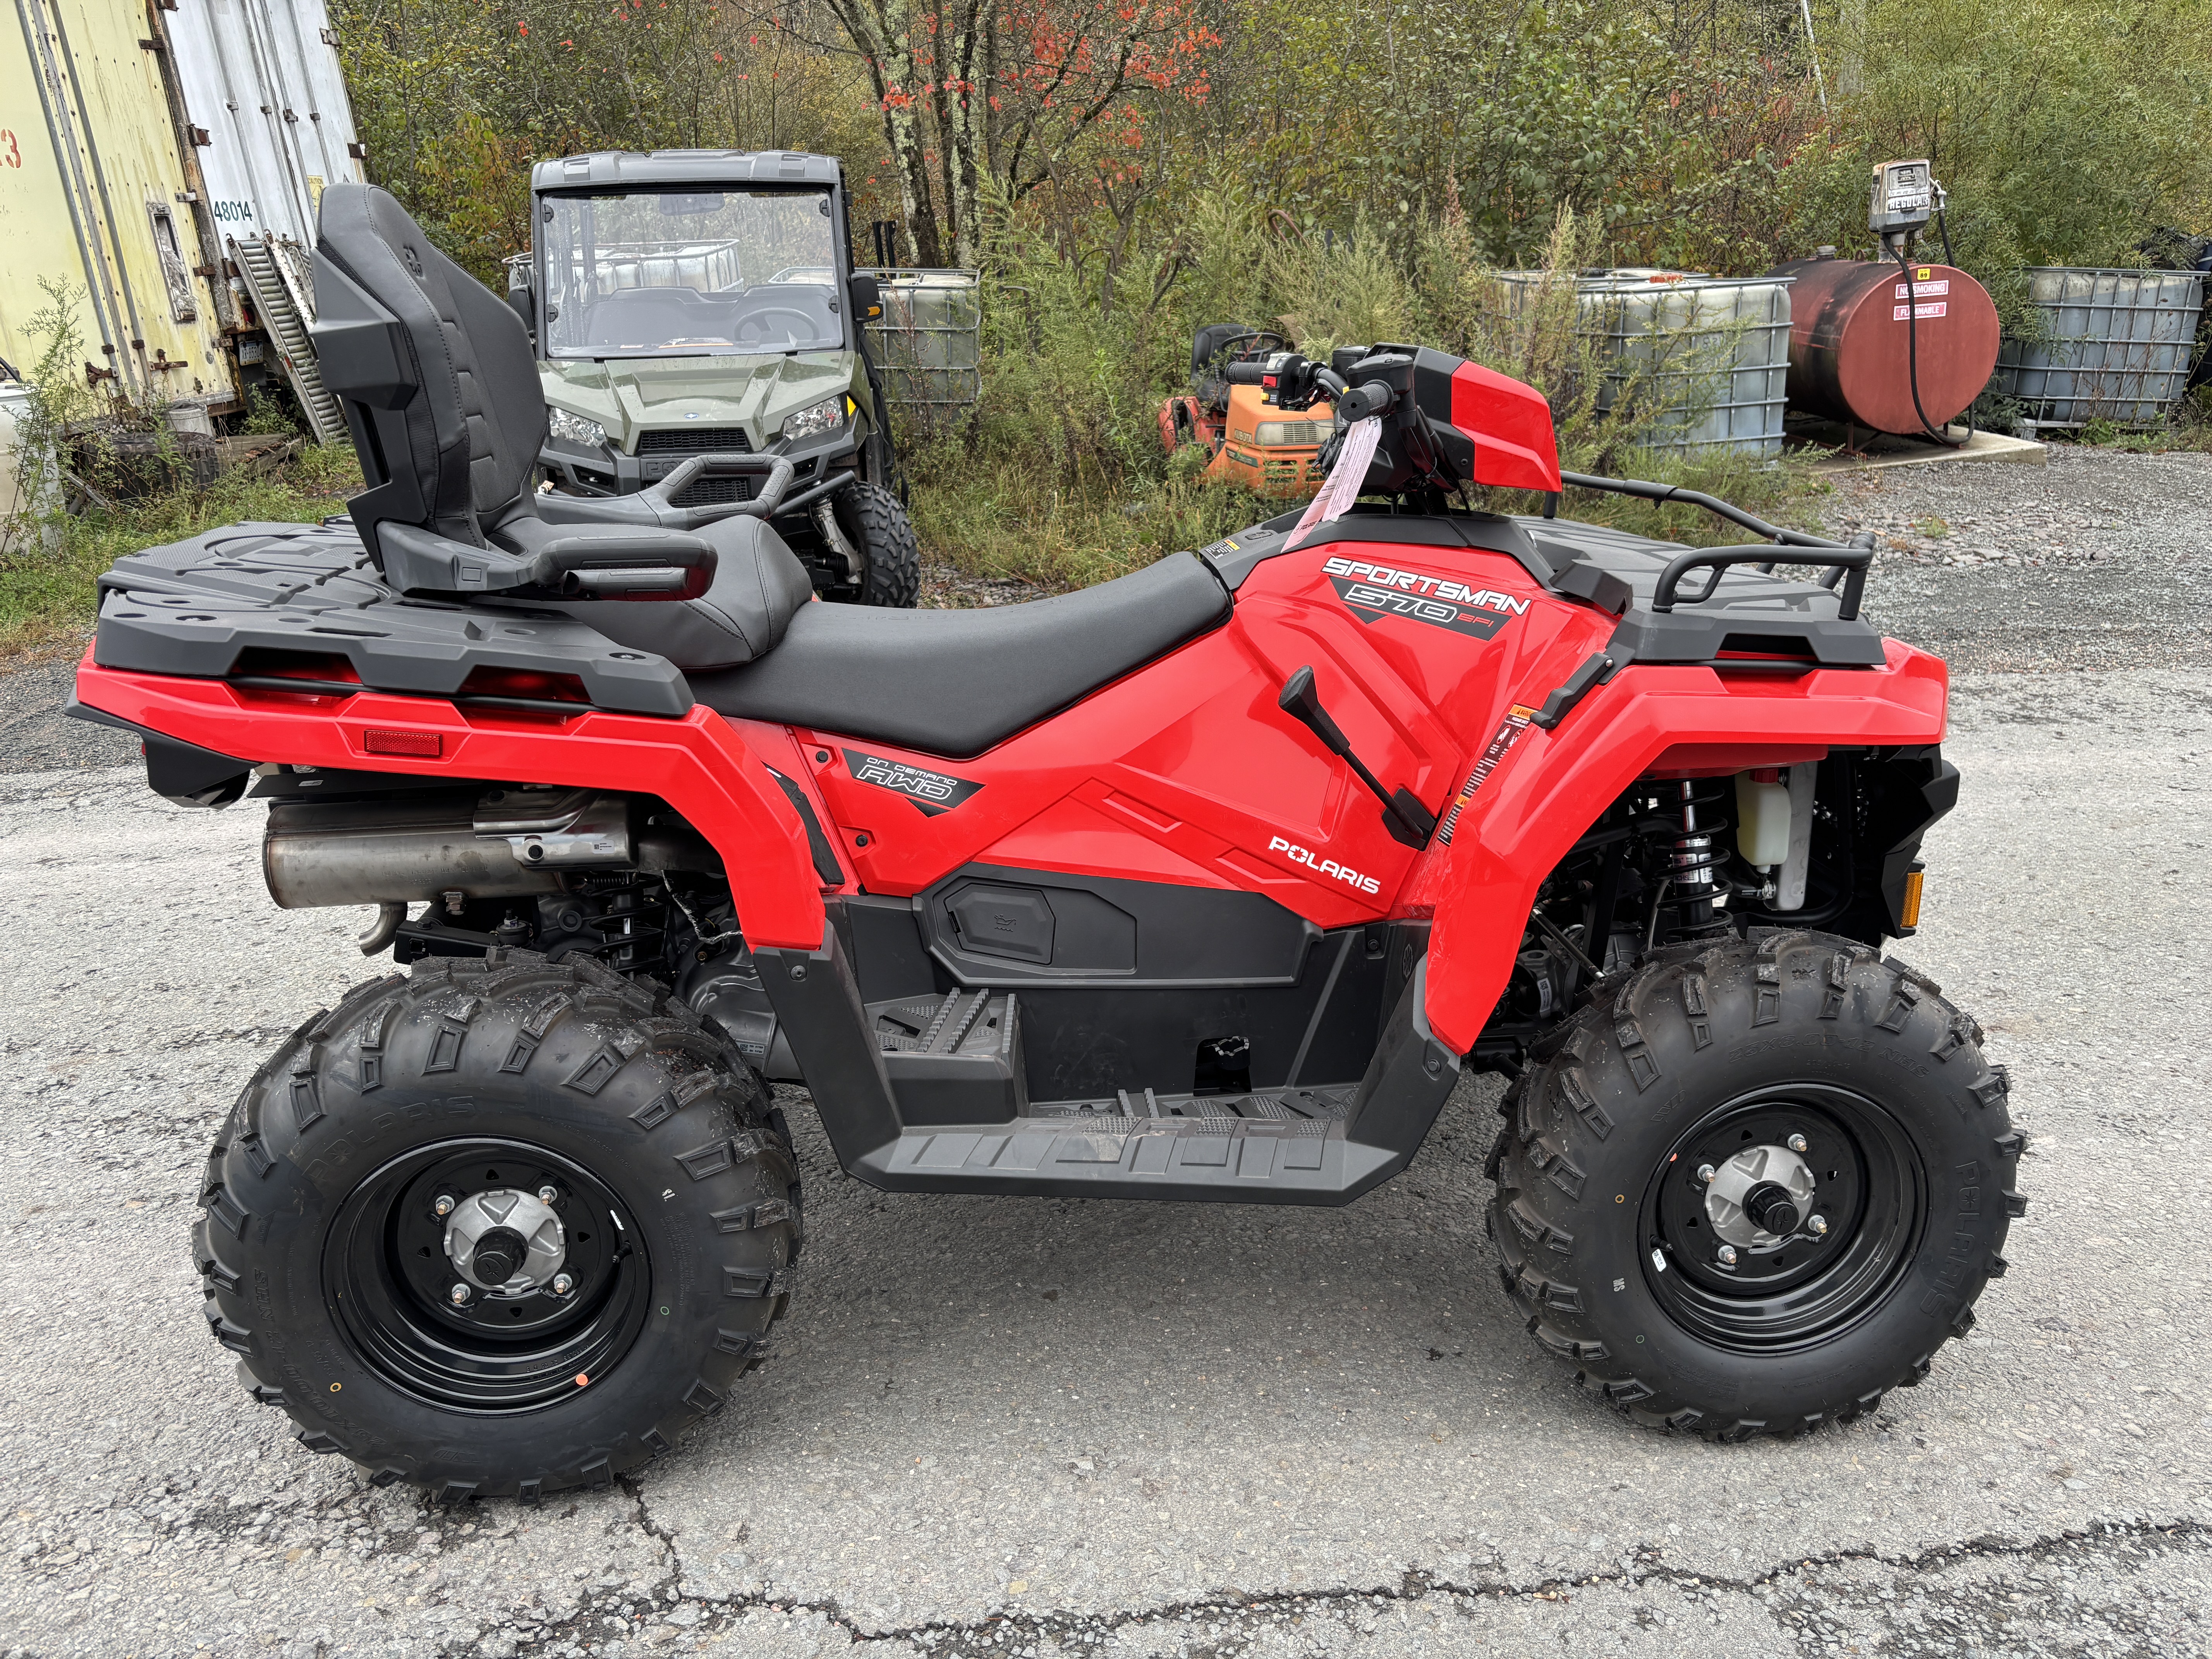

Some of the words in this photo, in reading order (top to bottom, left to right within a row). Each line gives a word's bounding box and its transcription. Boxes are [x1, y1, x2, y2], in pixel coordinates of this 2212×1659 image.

[0, 129, 21, 168] 3
[214, 201, 252, 222] 48014
[1900, 287, 1909, 295] NO
[1913, 283, 1945, 294] SMOKING
[1234, 429, 1252, 444] KUBOTA
[1322, 556, 1532, 616] SPORTSMAN
[1344, 584, 1457, 622] 570
[1457, 613, 1494, 628] EFI
[856, 764, 952, 800] AWD
[894, 764, 957, 786] DEMAND
[1268, 836, 1381, 894] POLARIS
[1878, 1046, 1930, 1078] NHS
[301, 1096, 476, 1183] POLARIS
[1920, 1160, 1980, 1317] POLARIS
[254, 1268, 275, 1322] NHS
